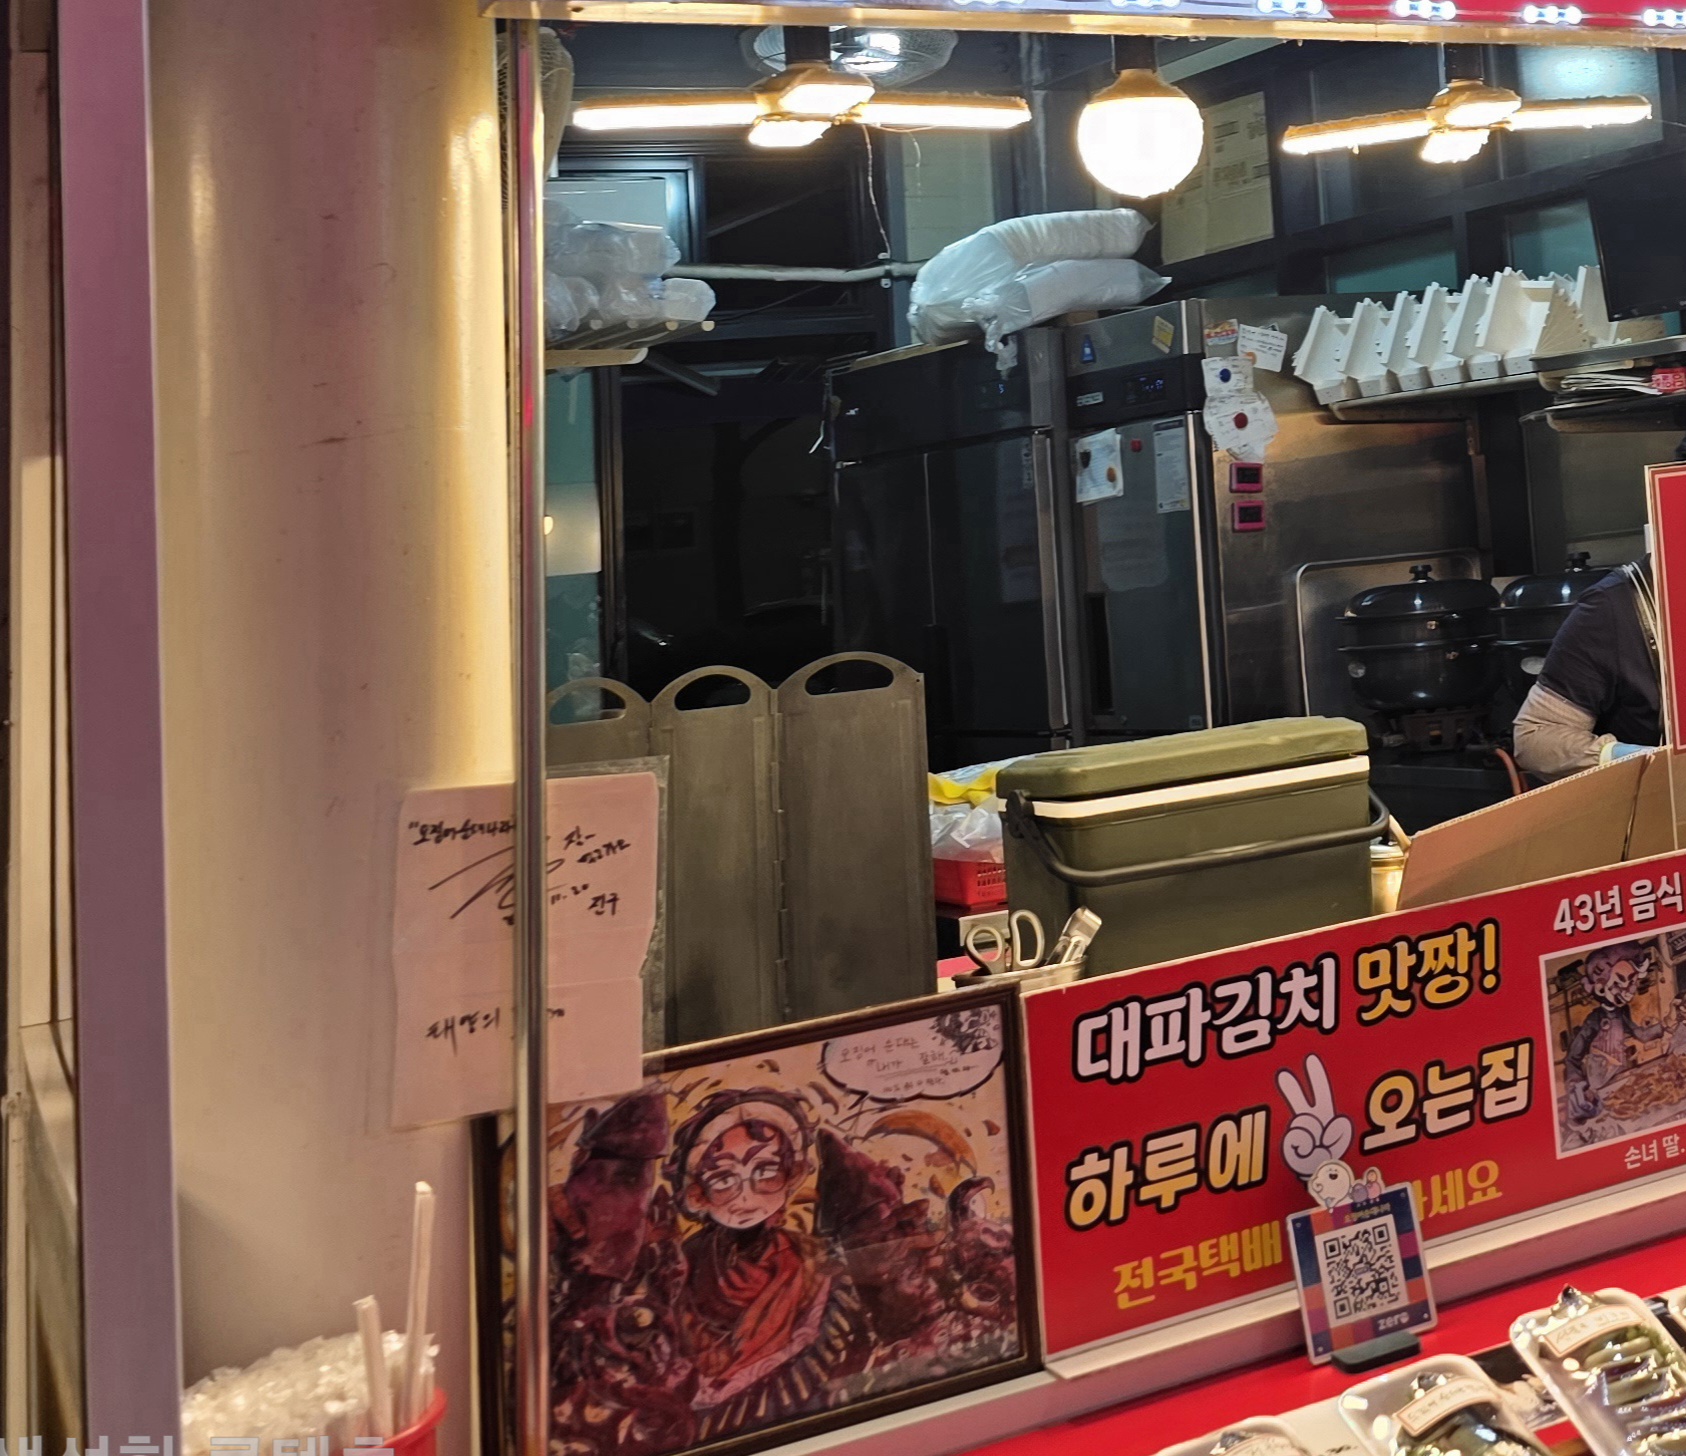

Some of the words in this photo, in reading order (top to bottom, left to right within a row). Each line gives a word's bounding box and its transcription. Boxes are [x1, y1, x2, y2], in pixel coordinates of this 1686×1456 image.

[1553, 892, 1624, 936] 43년
[1629, 874, 1682, 915] 음식
[1074, 956, 1338, 1084] 대파김치
[1355, 918, 1501, 1024] 맛짱!
[1066, 1108, 1270, 1230] 하루에
[1363, 1039, 1534, 1154] 오는집
[1624, 1139, 1660, 1170] 손녀
[1113, 1220, 1283, 1311] 전국택배
